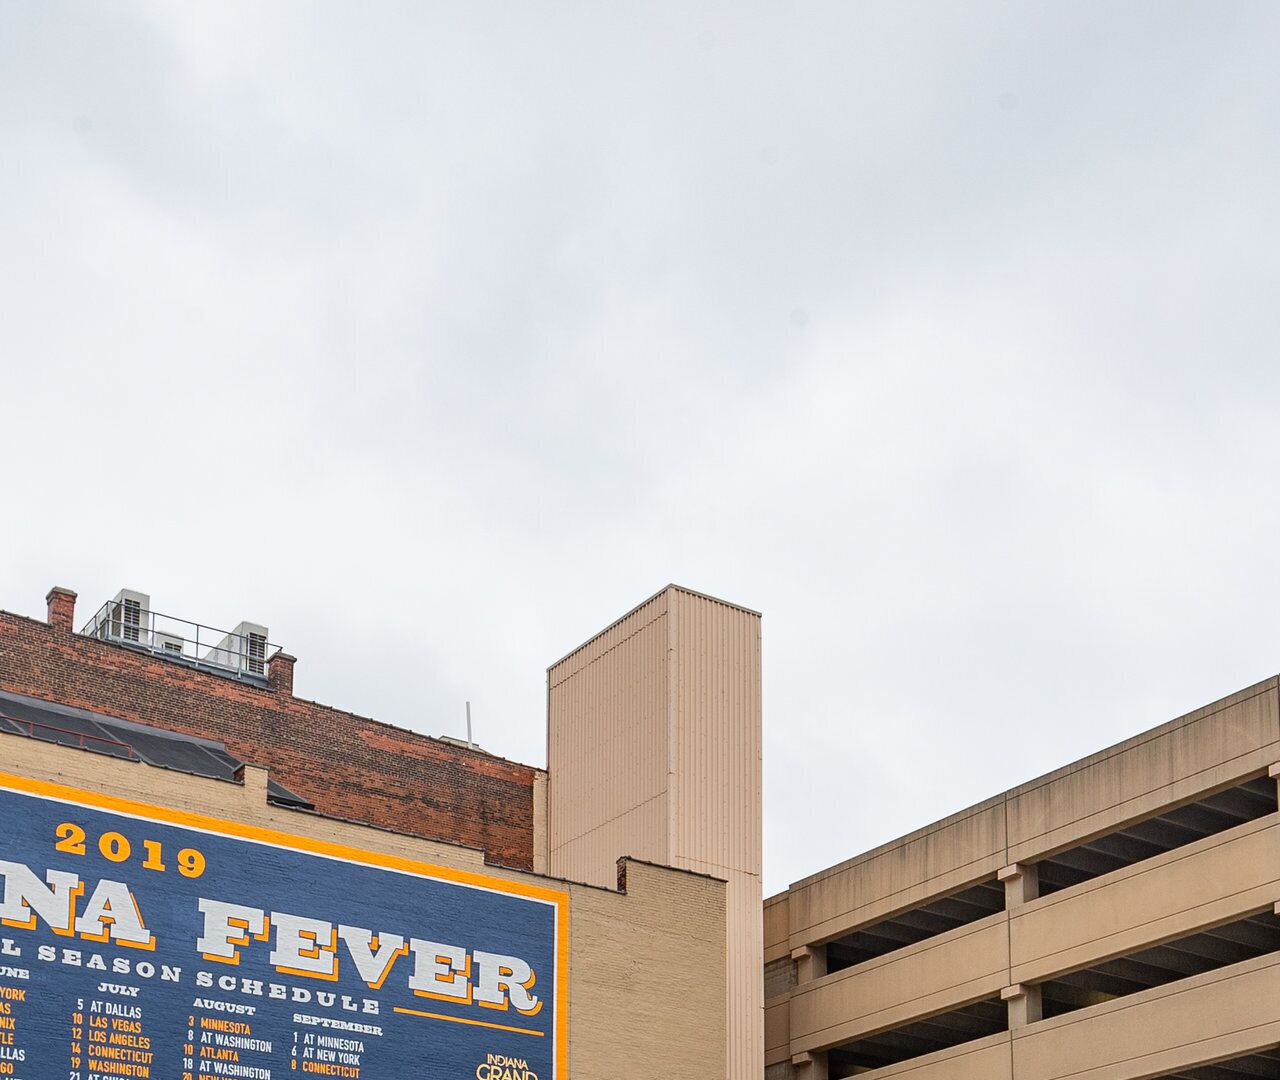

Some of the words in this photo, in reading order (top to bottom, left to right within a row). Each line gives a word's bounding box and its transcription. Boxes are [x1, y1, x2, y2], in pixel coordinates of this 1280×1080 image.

[55, 822, 206, 879] 2019
[196, 897, 544, 1014] FEVER
[37, 945, 182, 983] SEASON
[196, 971, 381, 1015] SCHEDULE
[97, 982, 141, 998] JULY
[77, 998, 84, 1011] 5
[89, 999, 104, 1013] AT
[105, 1002, 142, 1019] DALLAS
[192, 997, 257, 1016] AUGUST
[71, 1012, 83, 1025] 10
[89, 1015, 109, 1029] LAS
[111, 1017, 142, 1035] VEGAS
[187, 1015, 195, 1027] 3
[200, 1016, 251, 1036] MINNESOTA
[293, 1013, 384, 1037] SEPTEMBER
[71, 1026, 83, 1040] 12
[88, 1029, 107, 1044] LOS
[108, 1032, 151, 1050] ANGELES
[187, 1029, 194, 1041] 8
[200, 1031, 213, 1044] AT
[214, 1033, 272, 1053] WASHINGTON
[293, 1031, 298, 1043] 1
[303, 1033, 315, 1045] AT
[317, 1035, 365, 1053] MINNESOTA
[70, 1041, 82, 1055] 14
[87, 1043, 155, 1065] CONNECTICUT
[183, 1043, 194, 1056] 10
[199, 1045, 239, 1063] ATLANTA
[291, 1045, 297, 1057] 6
[302, 1046, 315, 1059] AT
[316, 1048, 338, 1063] NEW
[337, 1051, 361, 1066] YORK
[487, 1053, 529, 1070] INDIANA
[70, 1056, 81, 1069] 19
[87, 1058, 150, 1079] WASHINGTON
[182, 1057, 194, 1070] 18
[199, 1059, 212, 1072] AT
[213, 1061, 271, 1080] WASHINGTON
[291, 1058, 297, 1071] 8
[302, 1060, 361, 1079] CONNECTICUT
